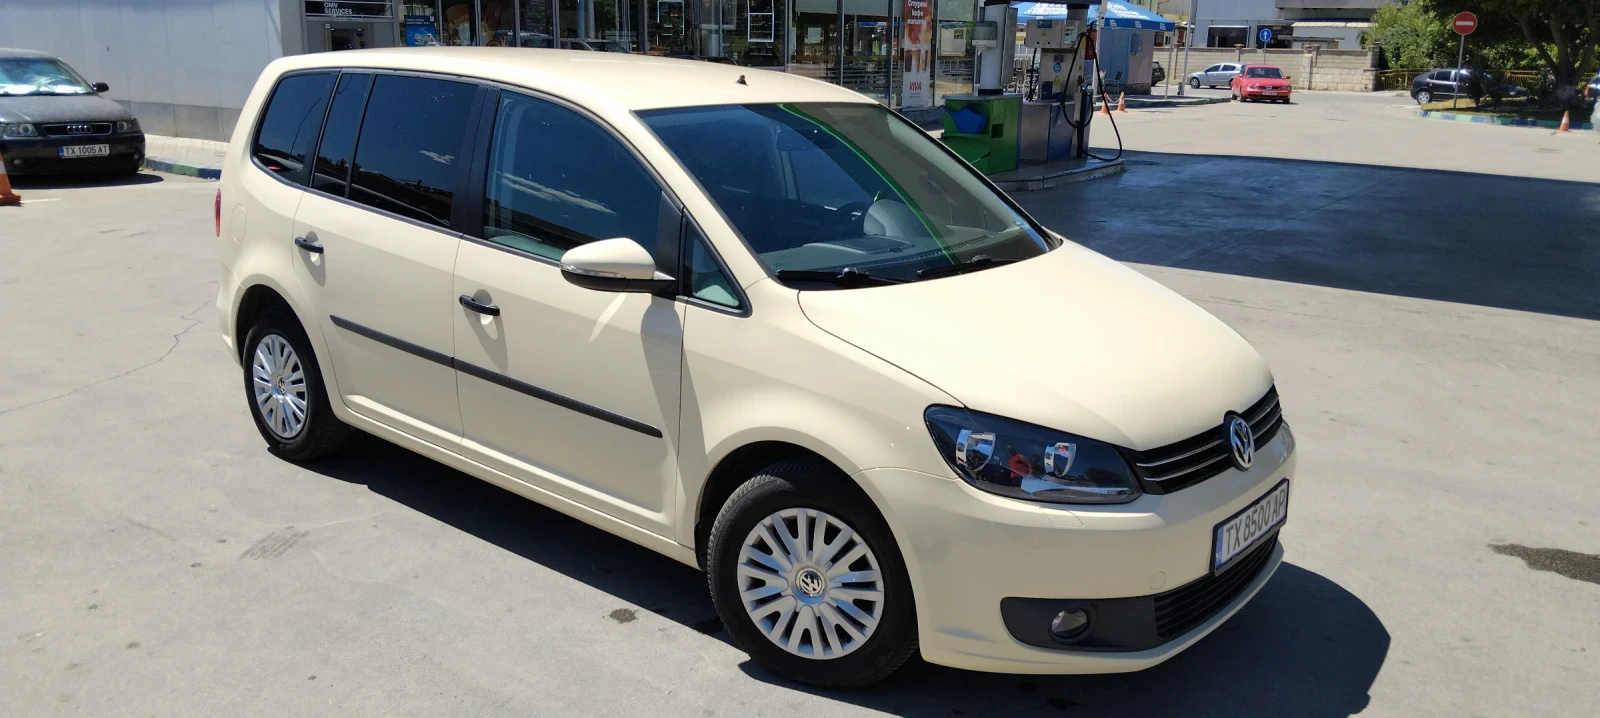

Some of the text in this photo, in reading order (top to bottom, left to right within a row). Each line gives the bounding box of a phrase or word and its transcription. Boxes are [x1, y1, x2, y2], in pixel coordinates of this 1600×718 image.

[909, 81, 922, 91] VIVA
[65, 145, 108, 155] TX 1005 AT
[1226, 518, 1242, 555] TX
[1244, 500, 1271, 543] 8500
[1272, 488, 1286, 522] AP
